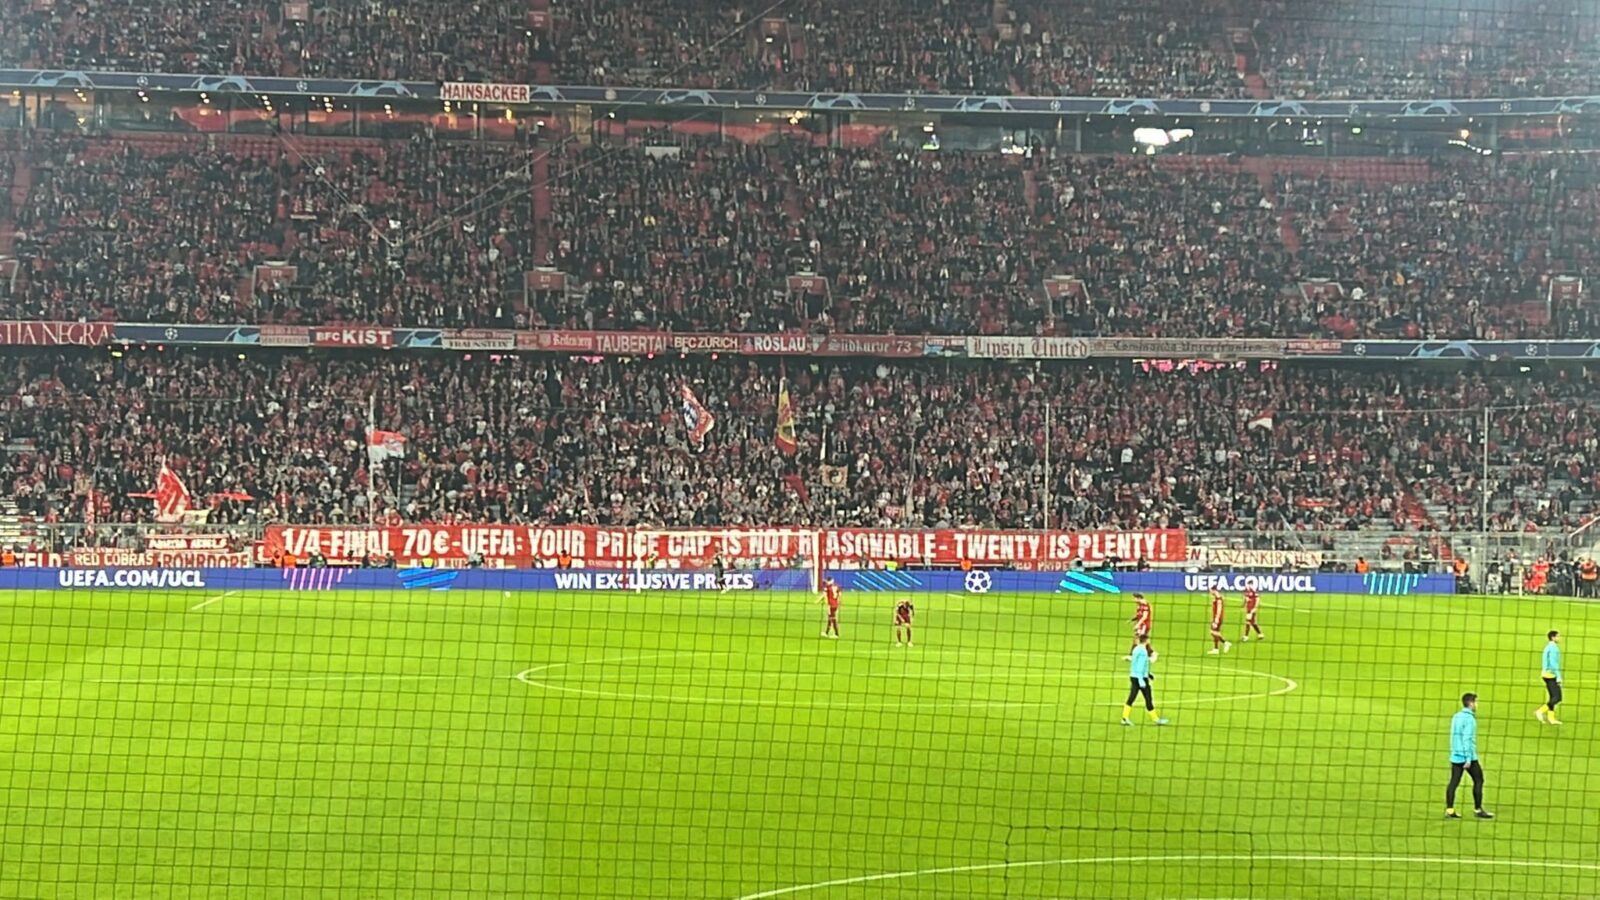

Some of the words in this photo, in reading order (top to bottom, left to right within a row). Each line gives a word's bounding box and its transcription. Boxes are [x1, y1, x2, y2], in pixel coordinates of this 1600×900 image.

[442, 84, 529, 101] HAINSACKER
[0, 323, 37, 345] TIA
[42, 323, 109, 346] NEGRA
[316, 332, 341, 341] BFC
[973, 338, 1025, 359] Lipsia
[1031, 338, 1088, 358] United
[527, 529, 586, 557] YOUR
[595, 531, 660, 558] PRICE
[667, 531, 712, 557] CAP
[721, 529, 743, 556] IS
[748, 529, 792, 556] NOT
[953, 533, 1041, 560] TWENTY
[1048, 534, 1071, 559] IS
[1077, 533, 1168, 560] PLENTY!
[74, 552, 100, 566] RED
[103, 552, 155, 567] COBRAS
[59, 570, 205, 587] UEFA.COM/UCL
[554, 573, 592, 589] WIN
[693, 573, 754, 590] PRZES
[1184, 575, 1316, 592] UEFA.COM/UCL
